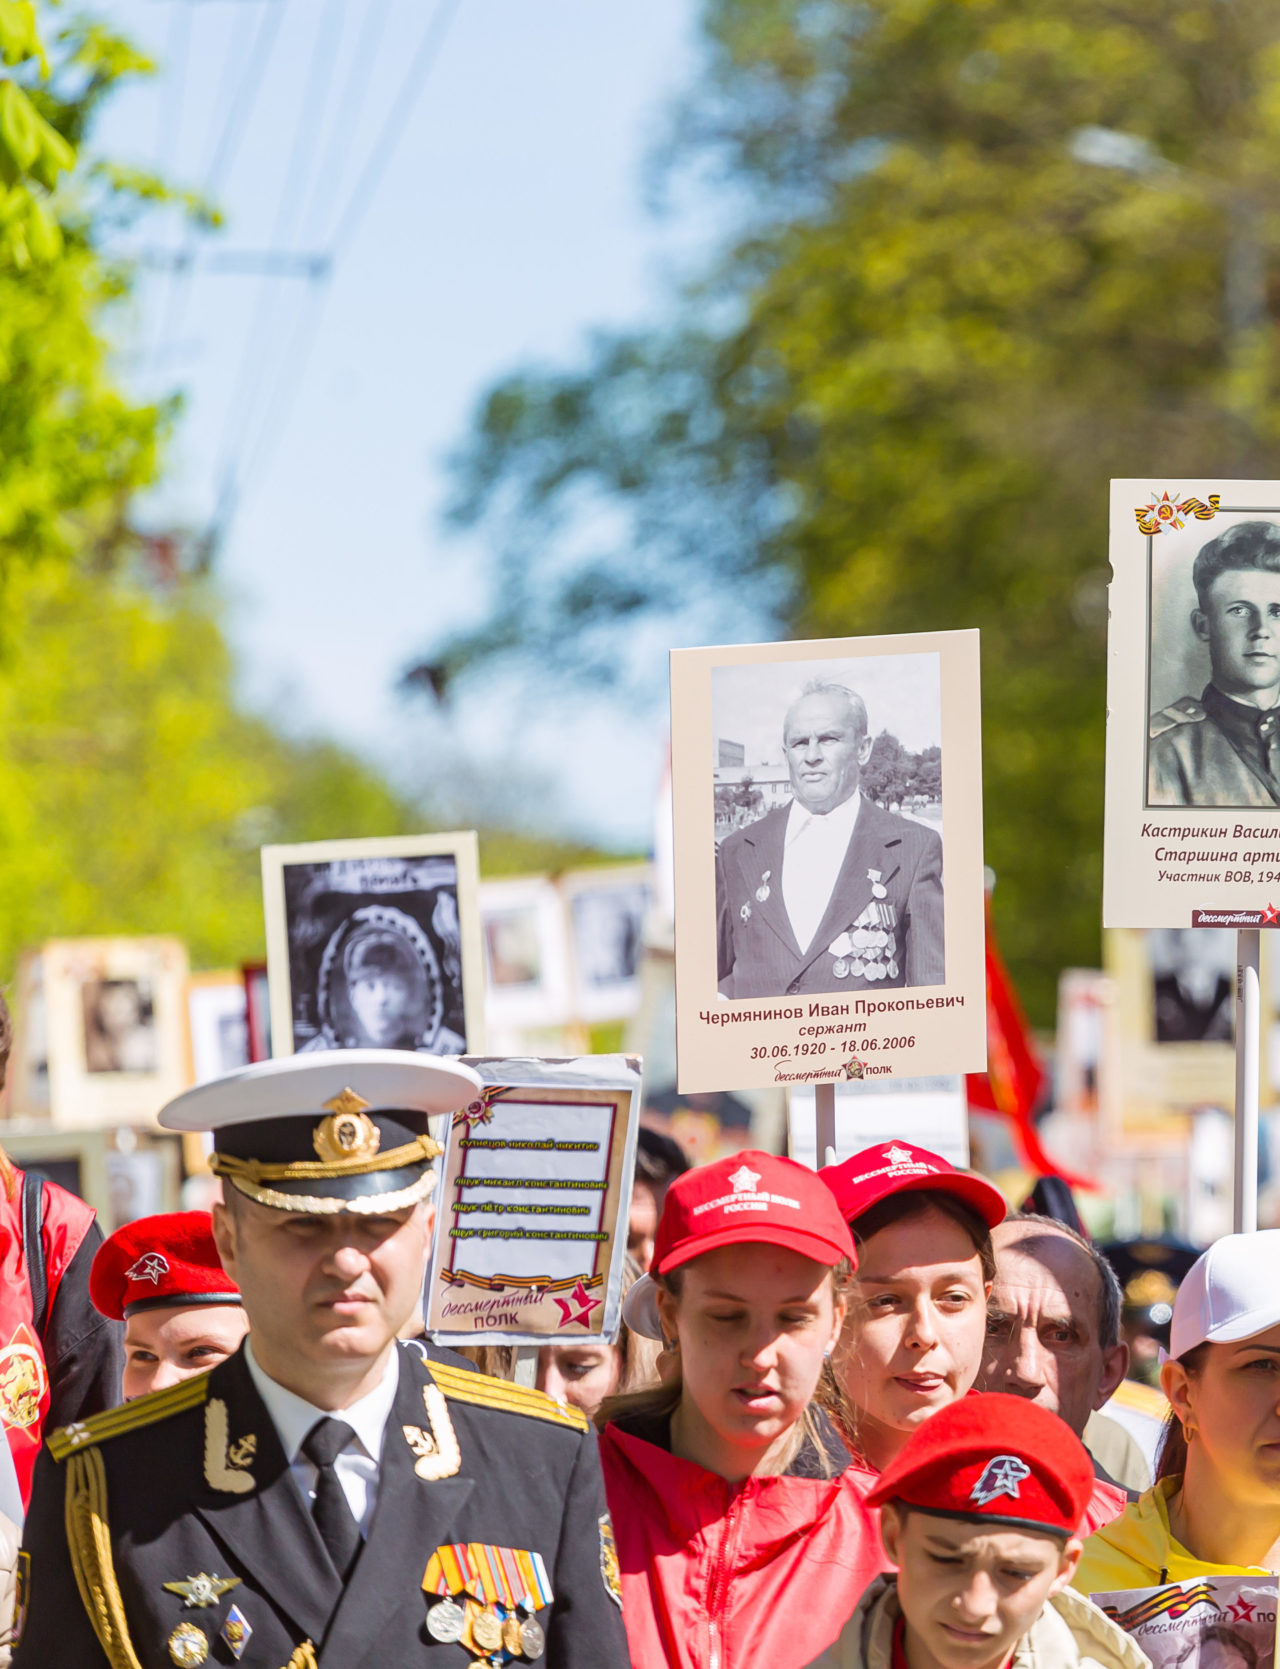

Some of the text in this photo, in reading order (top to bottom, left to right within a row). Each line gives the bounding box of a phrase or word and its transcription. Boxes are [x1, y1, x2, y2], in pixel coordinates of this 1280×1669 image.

[1141, 823, 1227, 840] Кастрикин
[1154, 847, 1238, 864] Старшина
[1157, 870, 1221, 883] Участник
[1224, 871, 1255, 884] ВОВ,
[699, 995, 965, 1027] Чермянинов Иван Прокопьевич
[798, 1021, 867, 1038] сержант
[750, 1043, 826, 1060] 30.06.1920
[840, 1036, 915, 1054] 18.06.2006
